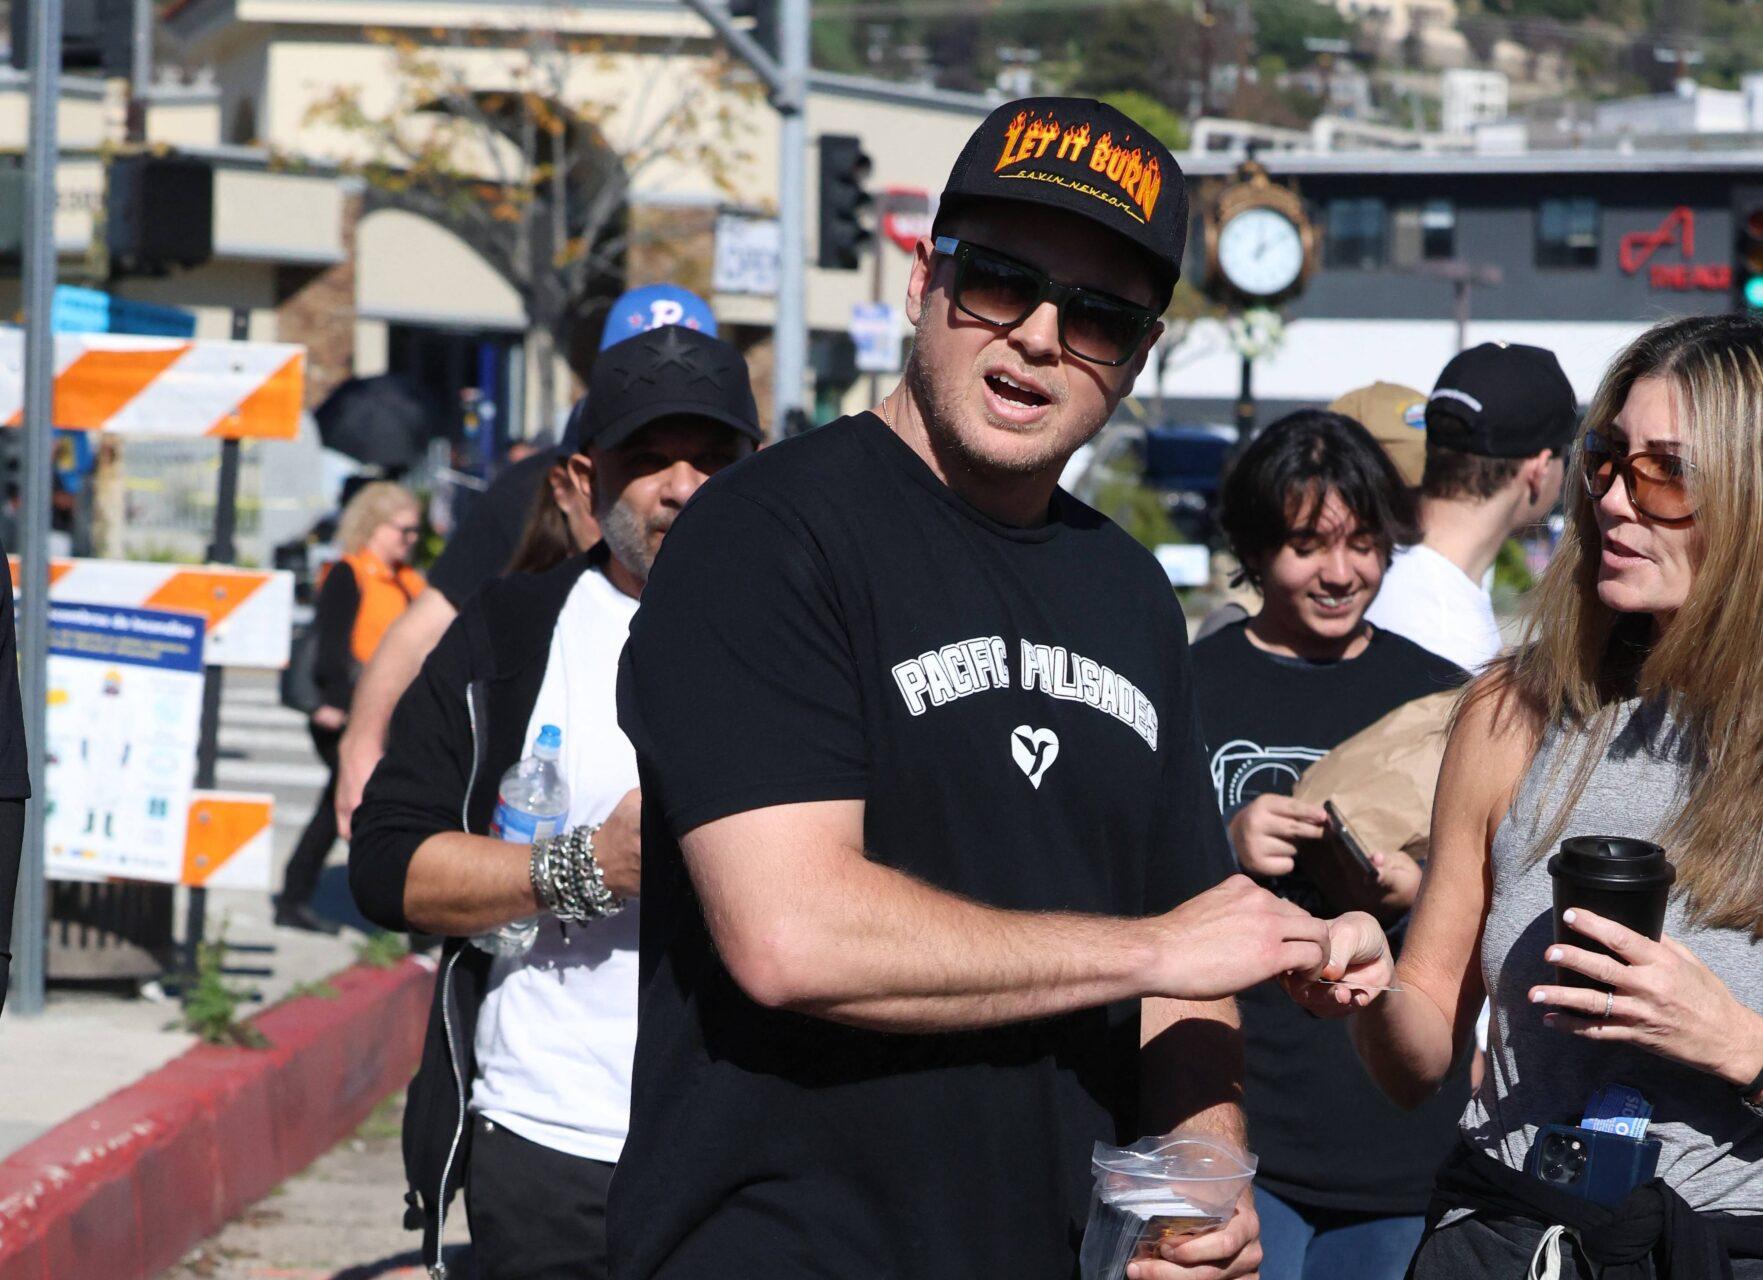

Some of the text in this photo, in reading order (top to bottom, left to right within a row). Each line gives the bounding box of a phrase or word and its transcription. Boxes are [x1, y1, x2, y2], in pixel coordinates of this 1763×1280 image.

[994, 111, 1162, 223] LET IT BURN
[1016, 170, 1131, 213] GAVIN NEWSOM
[892, 636, 1159, 751] PACIFIC PALISADES
